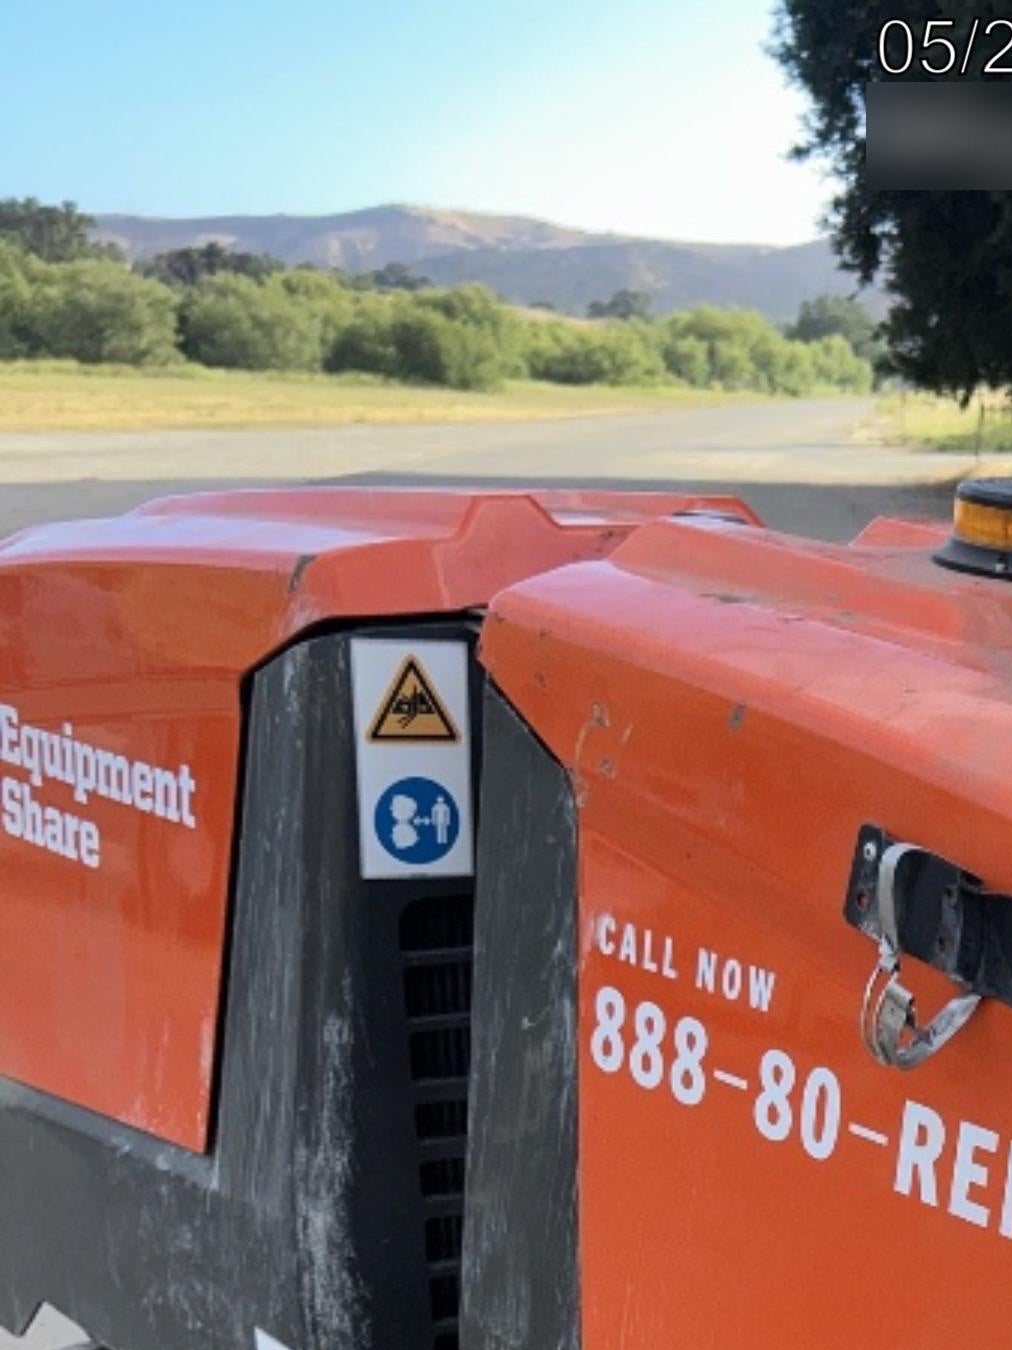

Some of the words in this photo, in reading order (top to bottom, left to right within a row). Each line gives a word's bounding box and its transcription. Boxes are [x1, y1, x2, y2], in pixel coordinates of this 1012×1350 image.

[0, 704, 196, 828] Equipment
[2, 776, 100, 868] Share
[596, 913, 678, 979] CALL
[696, 947, 775, 1012] NOW
